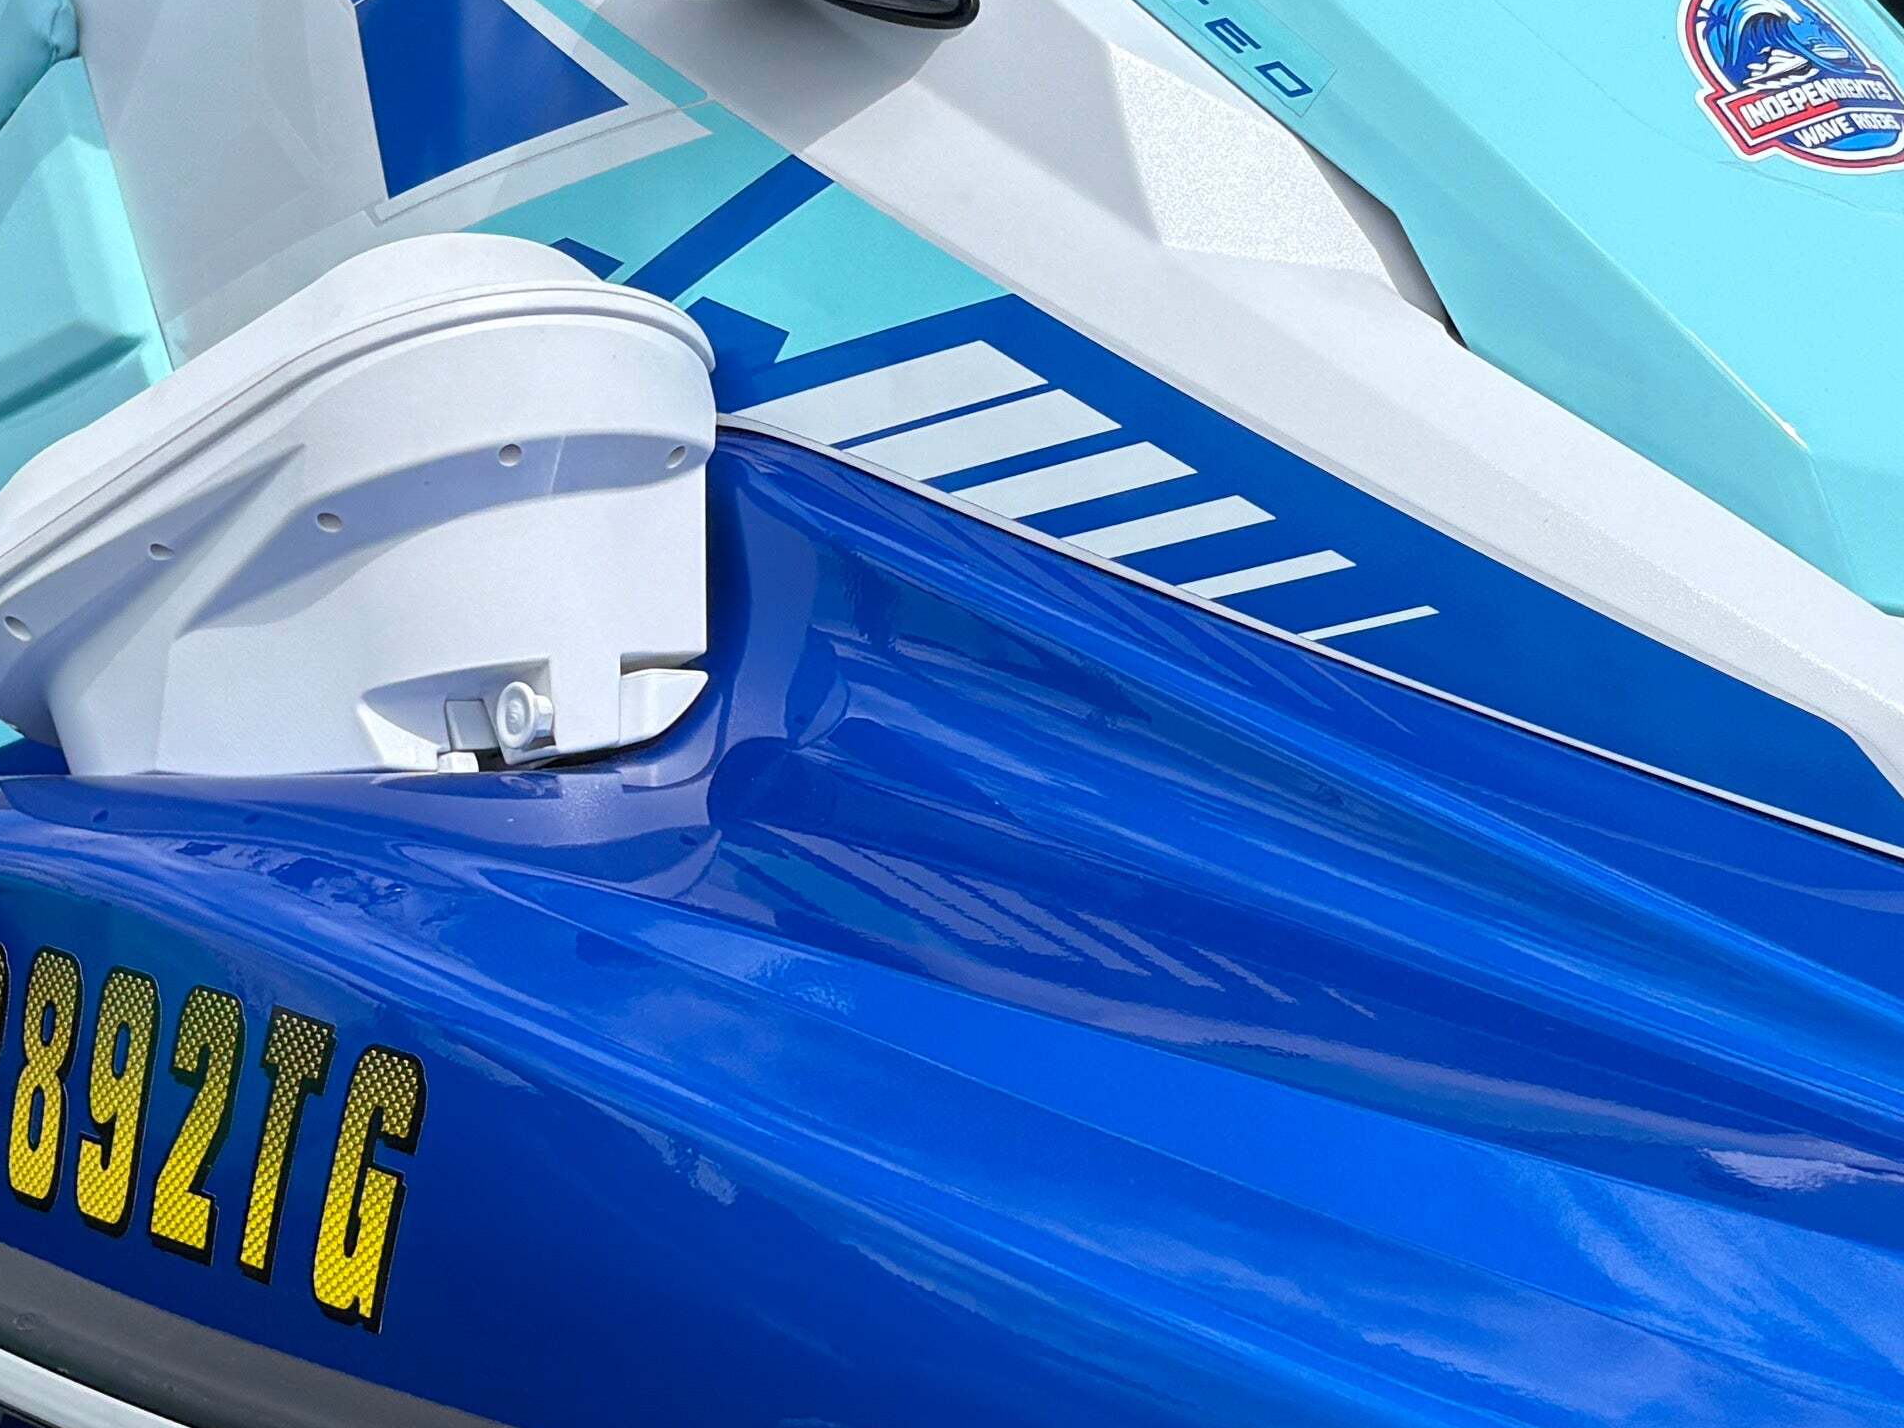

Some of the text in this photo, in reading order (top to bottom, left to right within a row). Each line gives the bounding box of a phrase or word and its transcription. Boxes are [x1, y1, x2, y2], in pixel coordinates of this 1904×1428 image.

[1739, 78, 1895, 129] INDEPENDIENTES
[1794, 112, 1900, 148] WAVE RIDERS
